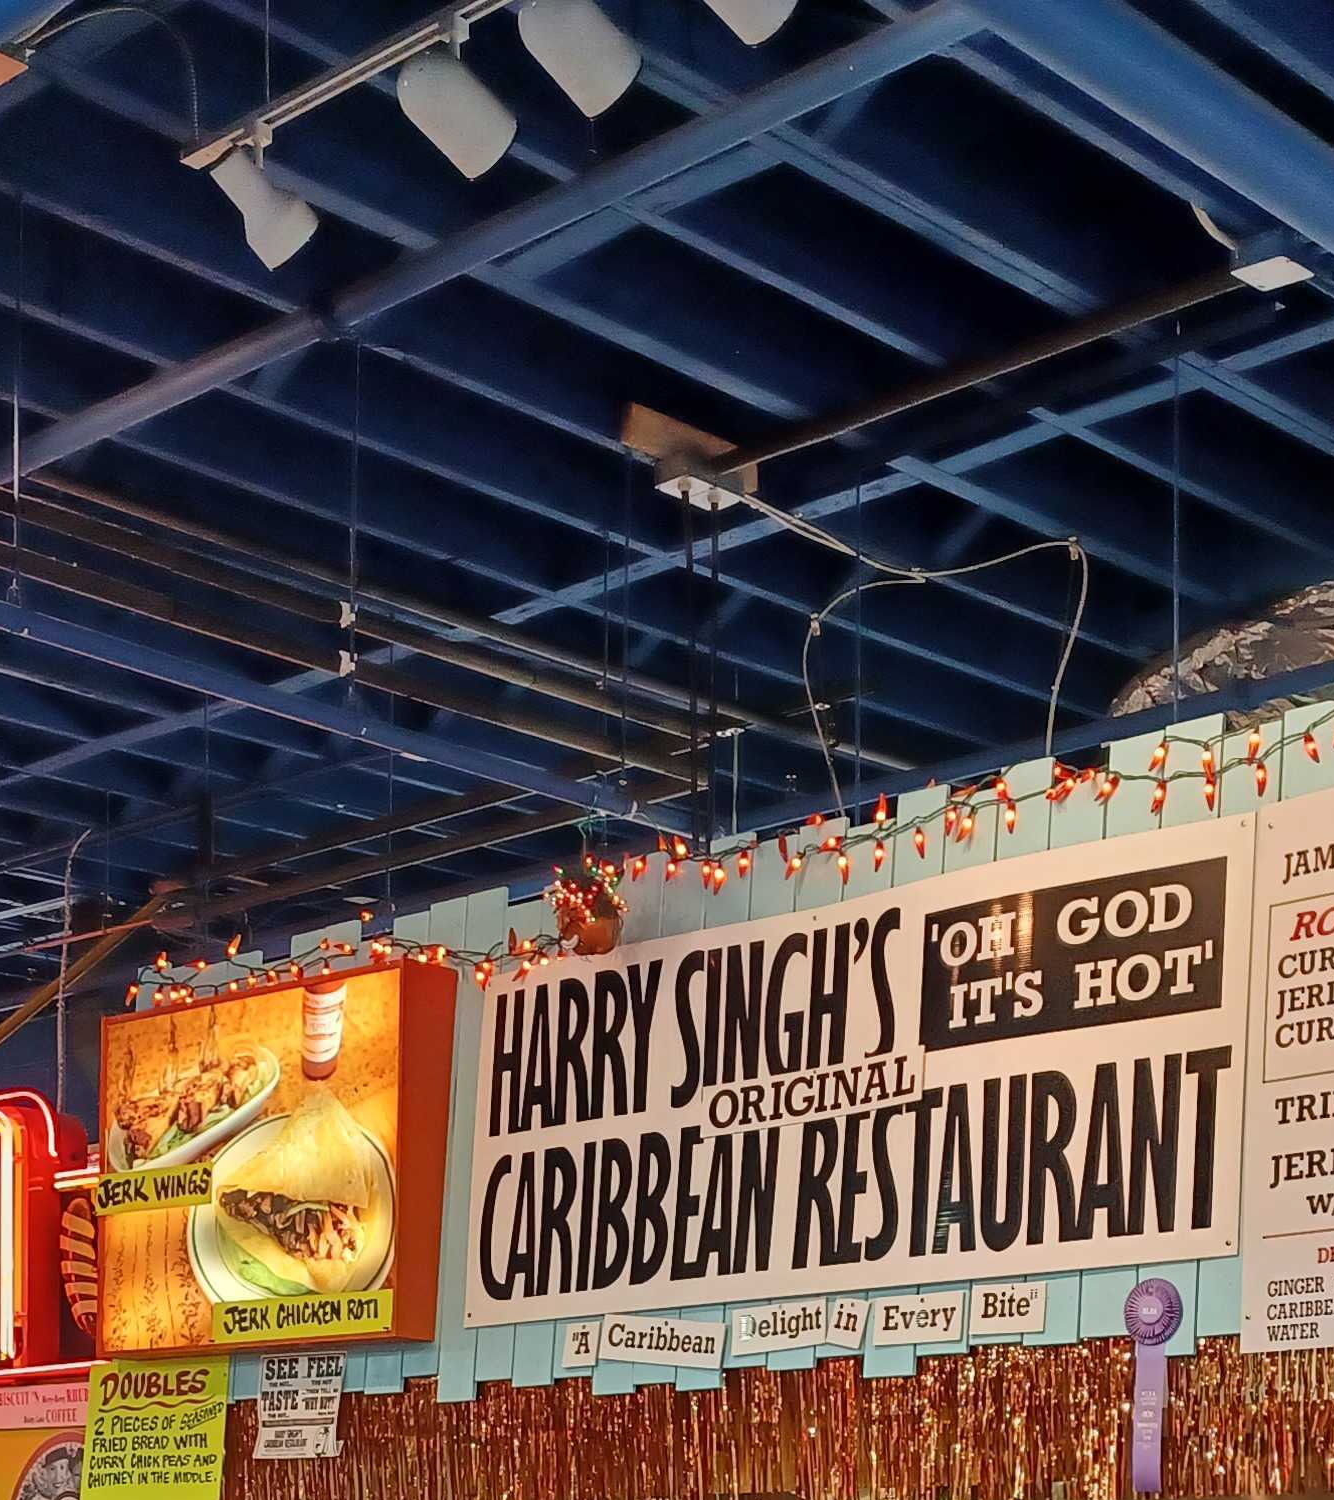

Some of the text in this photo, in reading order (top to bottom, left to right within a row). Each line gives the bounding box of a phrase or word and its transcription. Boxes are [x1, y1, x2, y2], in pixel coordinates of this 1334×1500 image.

[1057, 883, 1193, 946] GOD
[948, 942, 1215, 1031] IT'S HOT'
[488, 907, 902, 1137] HARRY SINGH'S
[709, 1055, 917, 1130] ORIGINAL
[478, 1044, 1233, 1301] CARIBBEAN RESTAURANT
[96, 1167, 212, 1210] JERK WINGS
[1267, 1276, 1325, 1298] GINGER
[223, 1297, 380, 1335] JERK CHICKEN ROTI
[608, 1322, 716, 1355] Caribbean
[738, 1306, 824, 1343] Delight
[833, 1308, 860, 1333] in
[881, 1302, 957, 1333] Every
[1266, 1322, 1320, 1342] WATER
[265, 1358, 299, 1381] SEE
[99, 1368, 211, 1406] DOUBLES
[262, 1390, 300, 1412] TASTE
[46, 1408, 78, 1424] COFFEE
[94, 1416, 105, 1436] 2
[110, 1415, 159, 1435] PIECES
[161, 1414, 177, 1430] OF
[92, 1433, 208, 1453] FRIED BREAD WITH
[89, 1453, 218, 1470] CURRY CHICK PEAS AND
[88, 1470, 135, 1489] CHUTNEY
[138, 1471, 149, 1485] IN
[151, 1471, 170, 1485] THE
